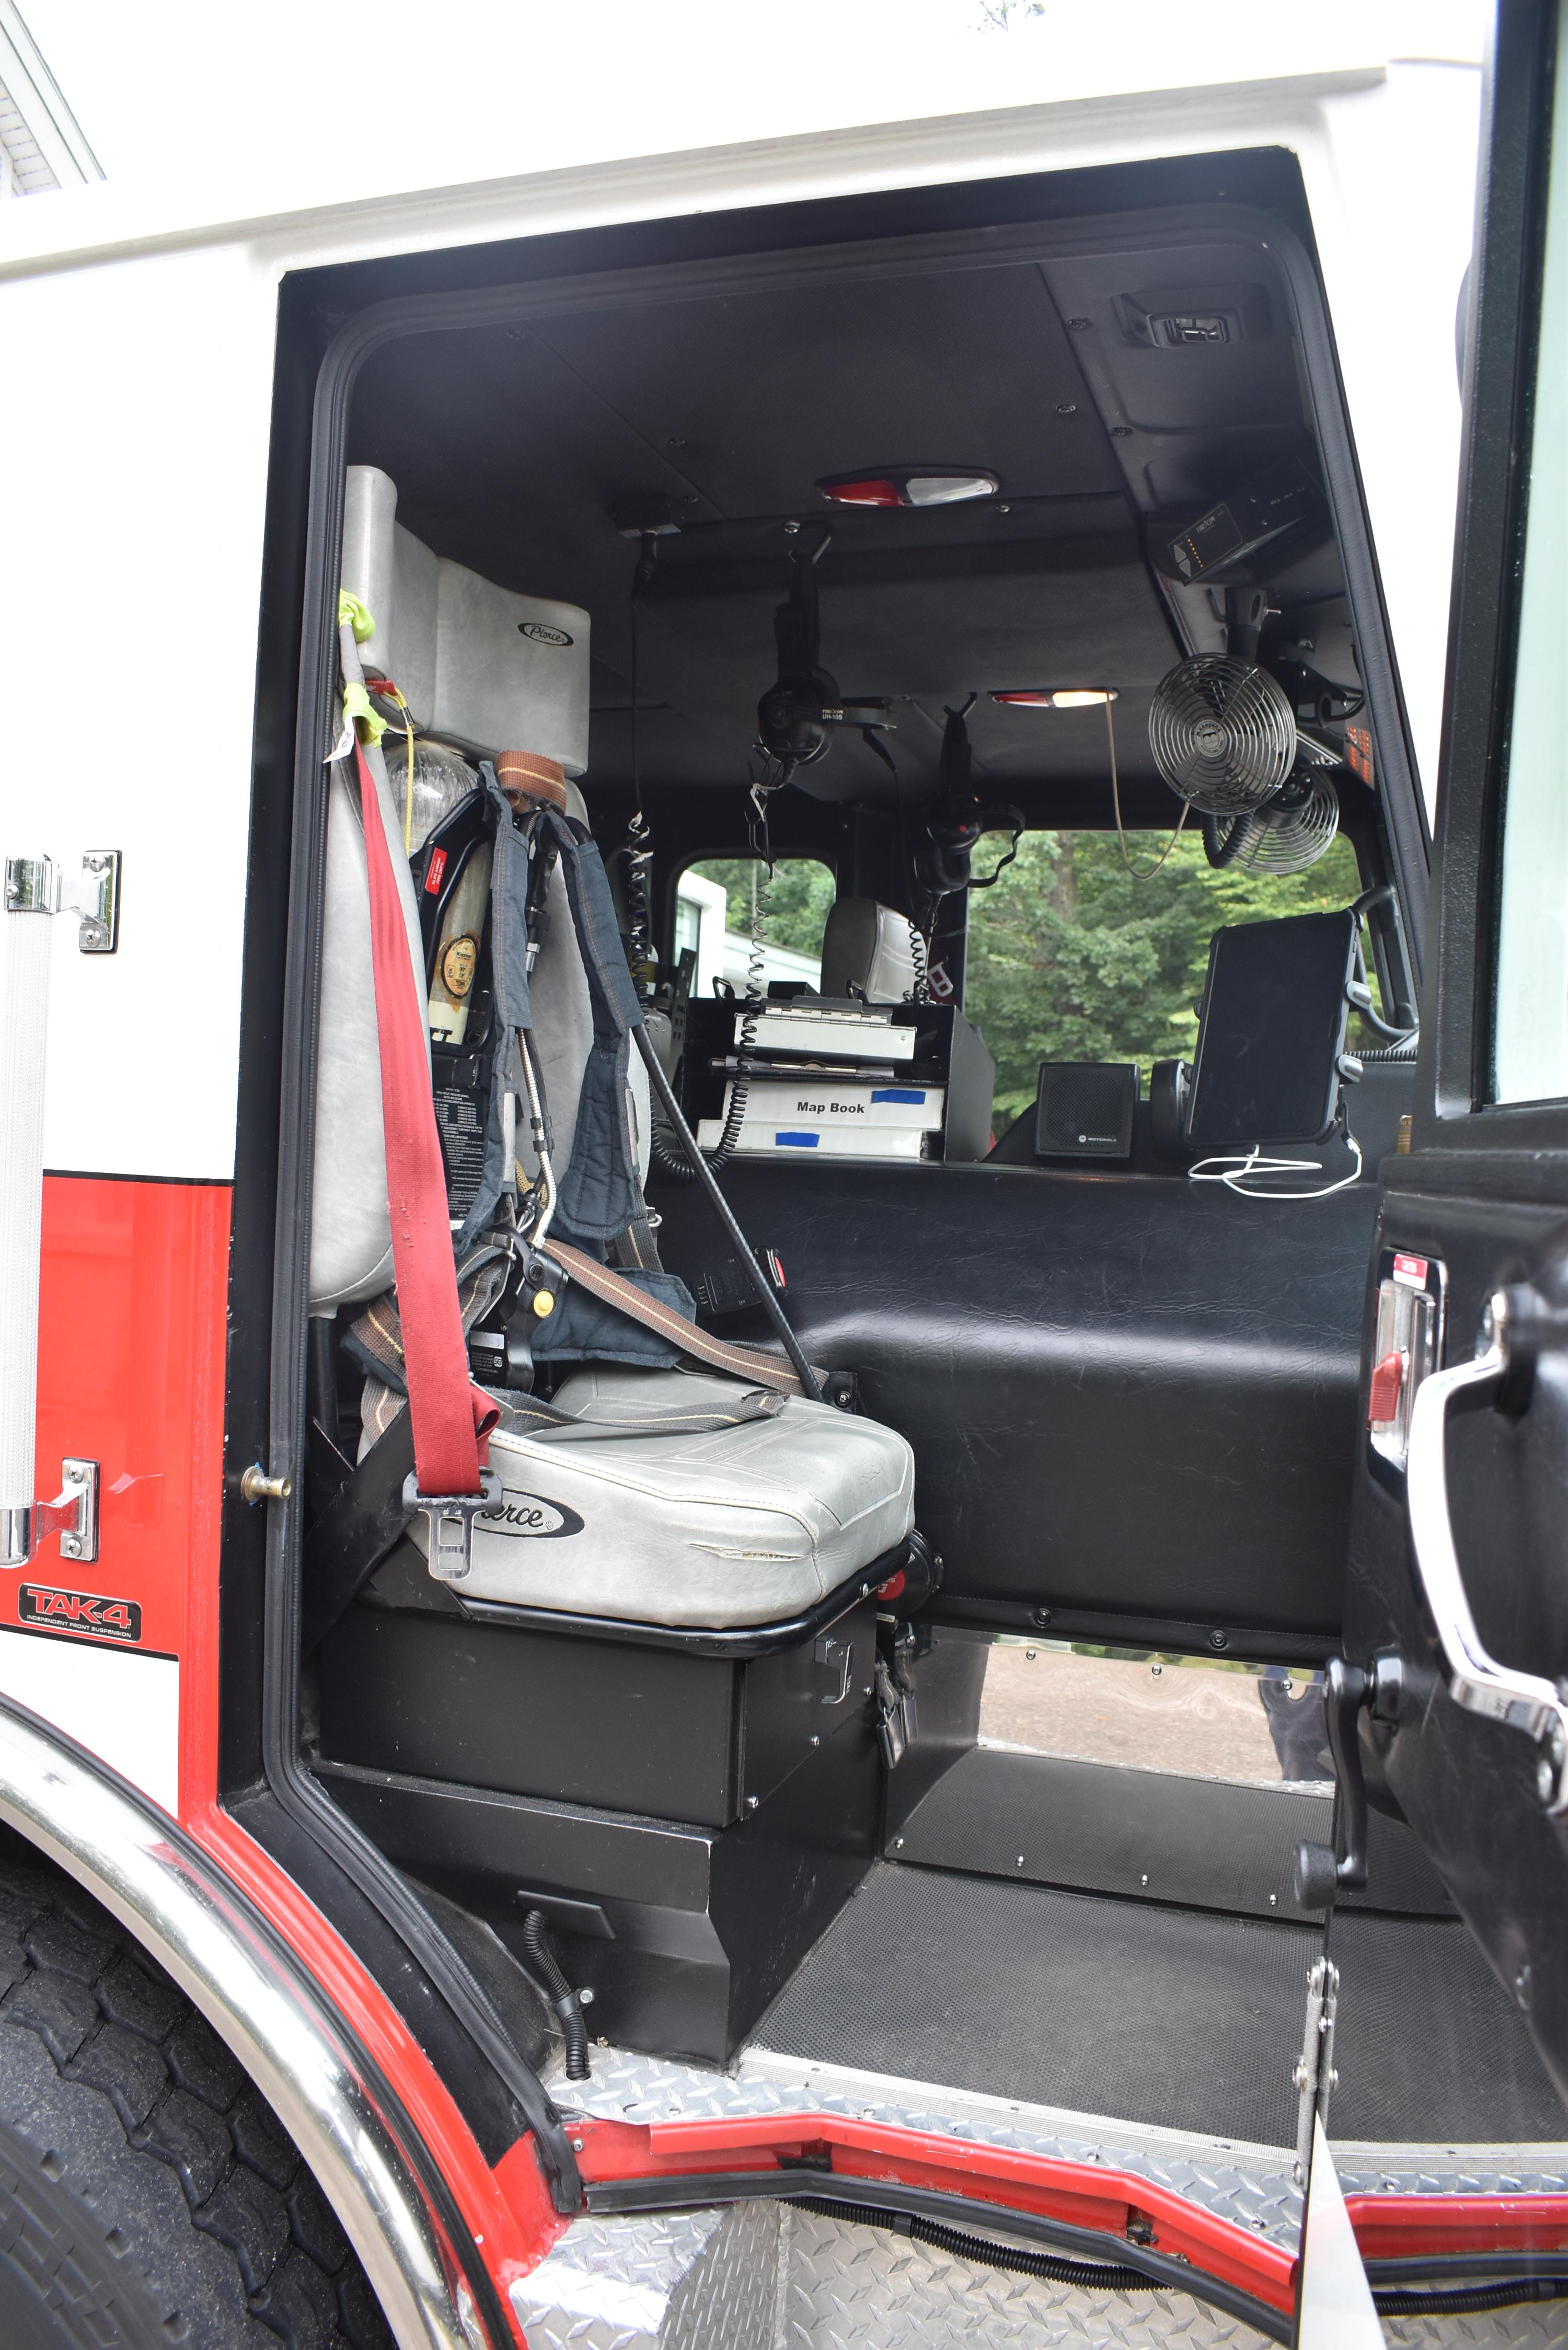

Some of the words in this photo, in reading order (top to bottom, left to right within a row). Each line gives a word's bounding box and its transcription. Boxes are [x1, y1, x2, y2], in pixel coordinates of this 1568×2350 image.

[530, 625, 561, 642] Pierce
[797, 1101, 825, 1114] Map
[830, 1102, 866, 1113] Book
[27, 1588, 132, 1629] TAK-4
[27, 1614, 68, 1627] INDEPENDENT
[70, 1622, 90, 1631] FRONT
[91, 1626, 132, 1638] SUSPENSION
